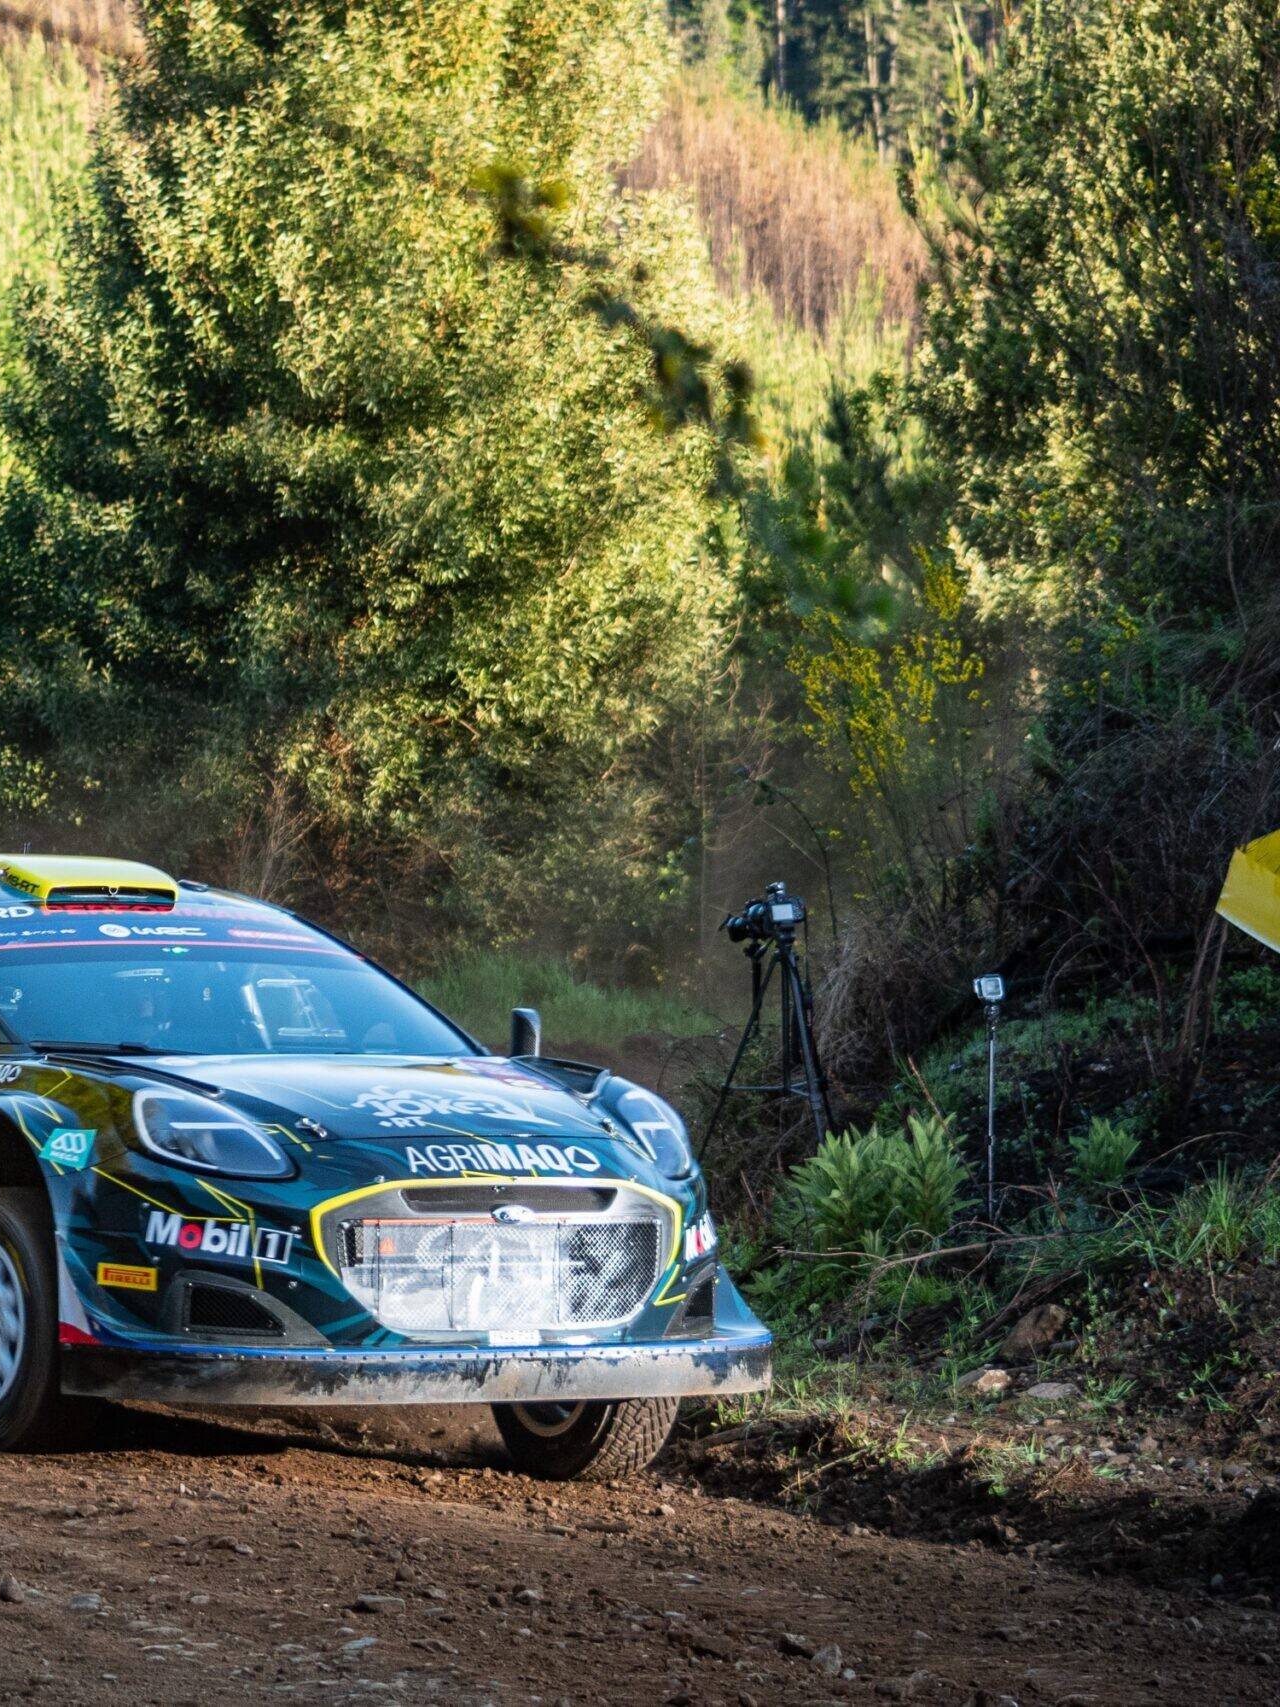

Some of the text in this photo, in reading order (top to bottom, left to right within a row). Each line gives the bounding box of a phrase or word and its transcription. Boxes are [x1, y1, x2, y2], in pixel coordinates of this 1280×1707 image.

[405, 1144, 573, 1174] AGRIMAQ
[145, 1210, 250, 1257] Mobil
[103, 1267, 151, 1286] PIRELLI
